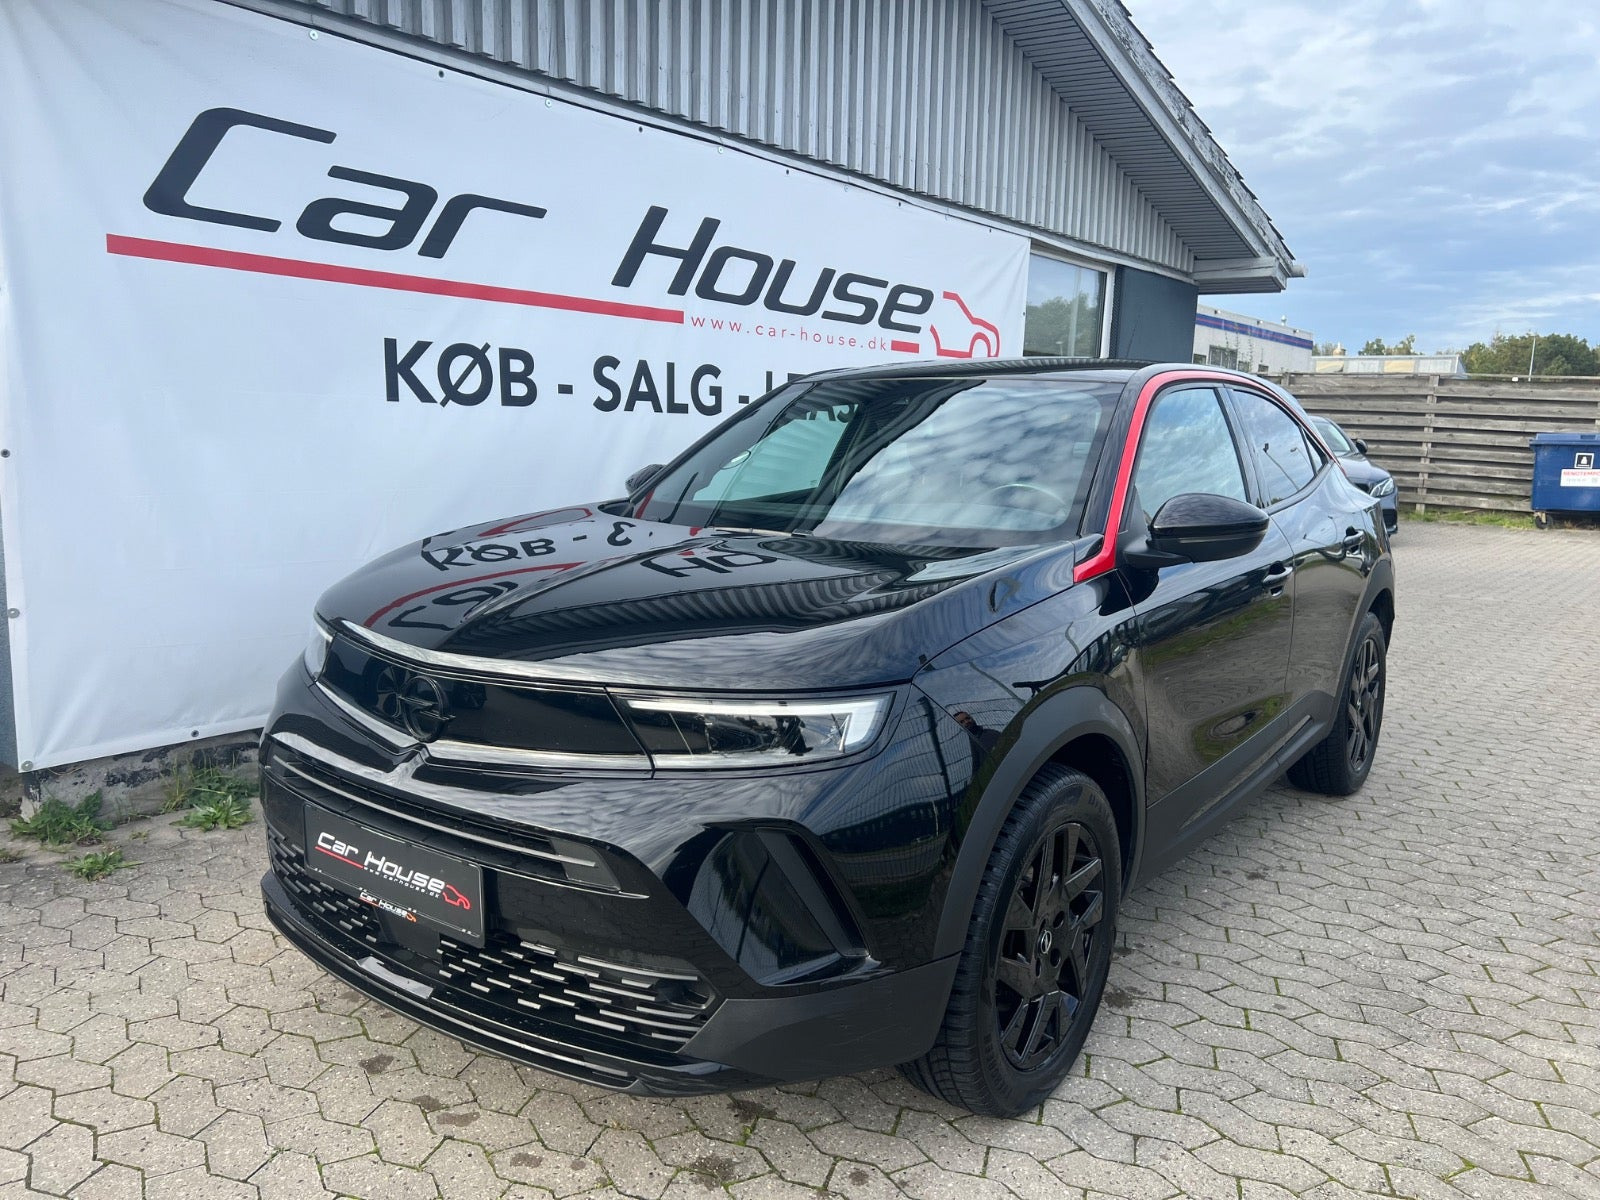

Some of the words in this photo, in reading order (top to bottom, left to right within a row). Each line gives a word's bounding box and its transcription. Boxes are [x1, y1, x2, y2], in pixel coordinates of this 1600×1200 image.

[143, 107, 548, 259] Car
[611, 205, 935, 334] House
[691, 314, 887, 351] www.car-house.dk
[383, 337, 539, 409] KØB
[592, 355, 724, 417] SALG
[317, 832, 359, 857] Car
